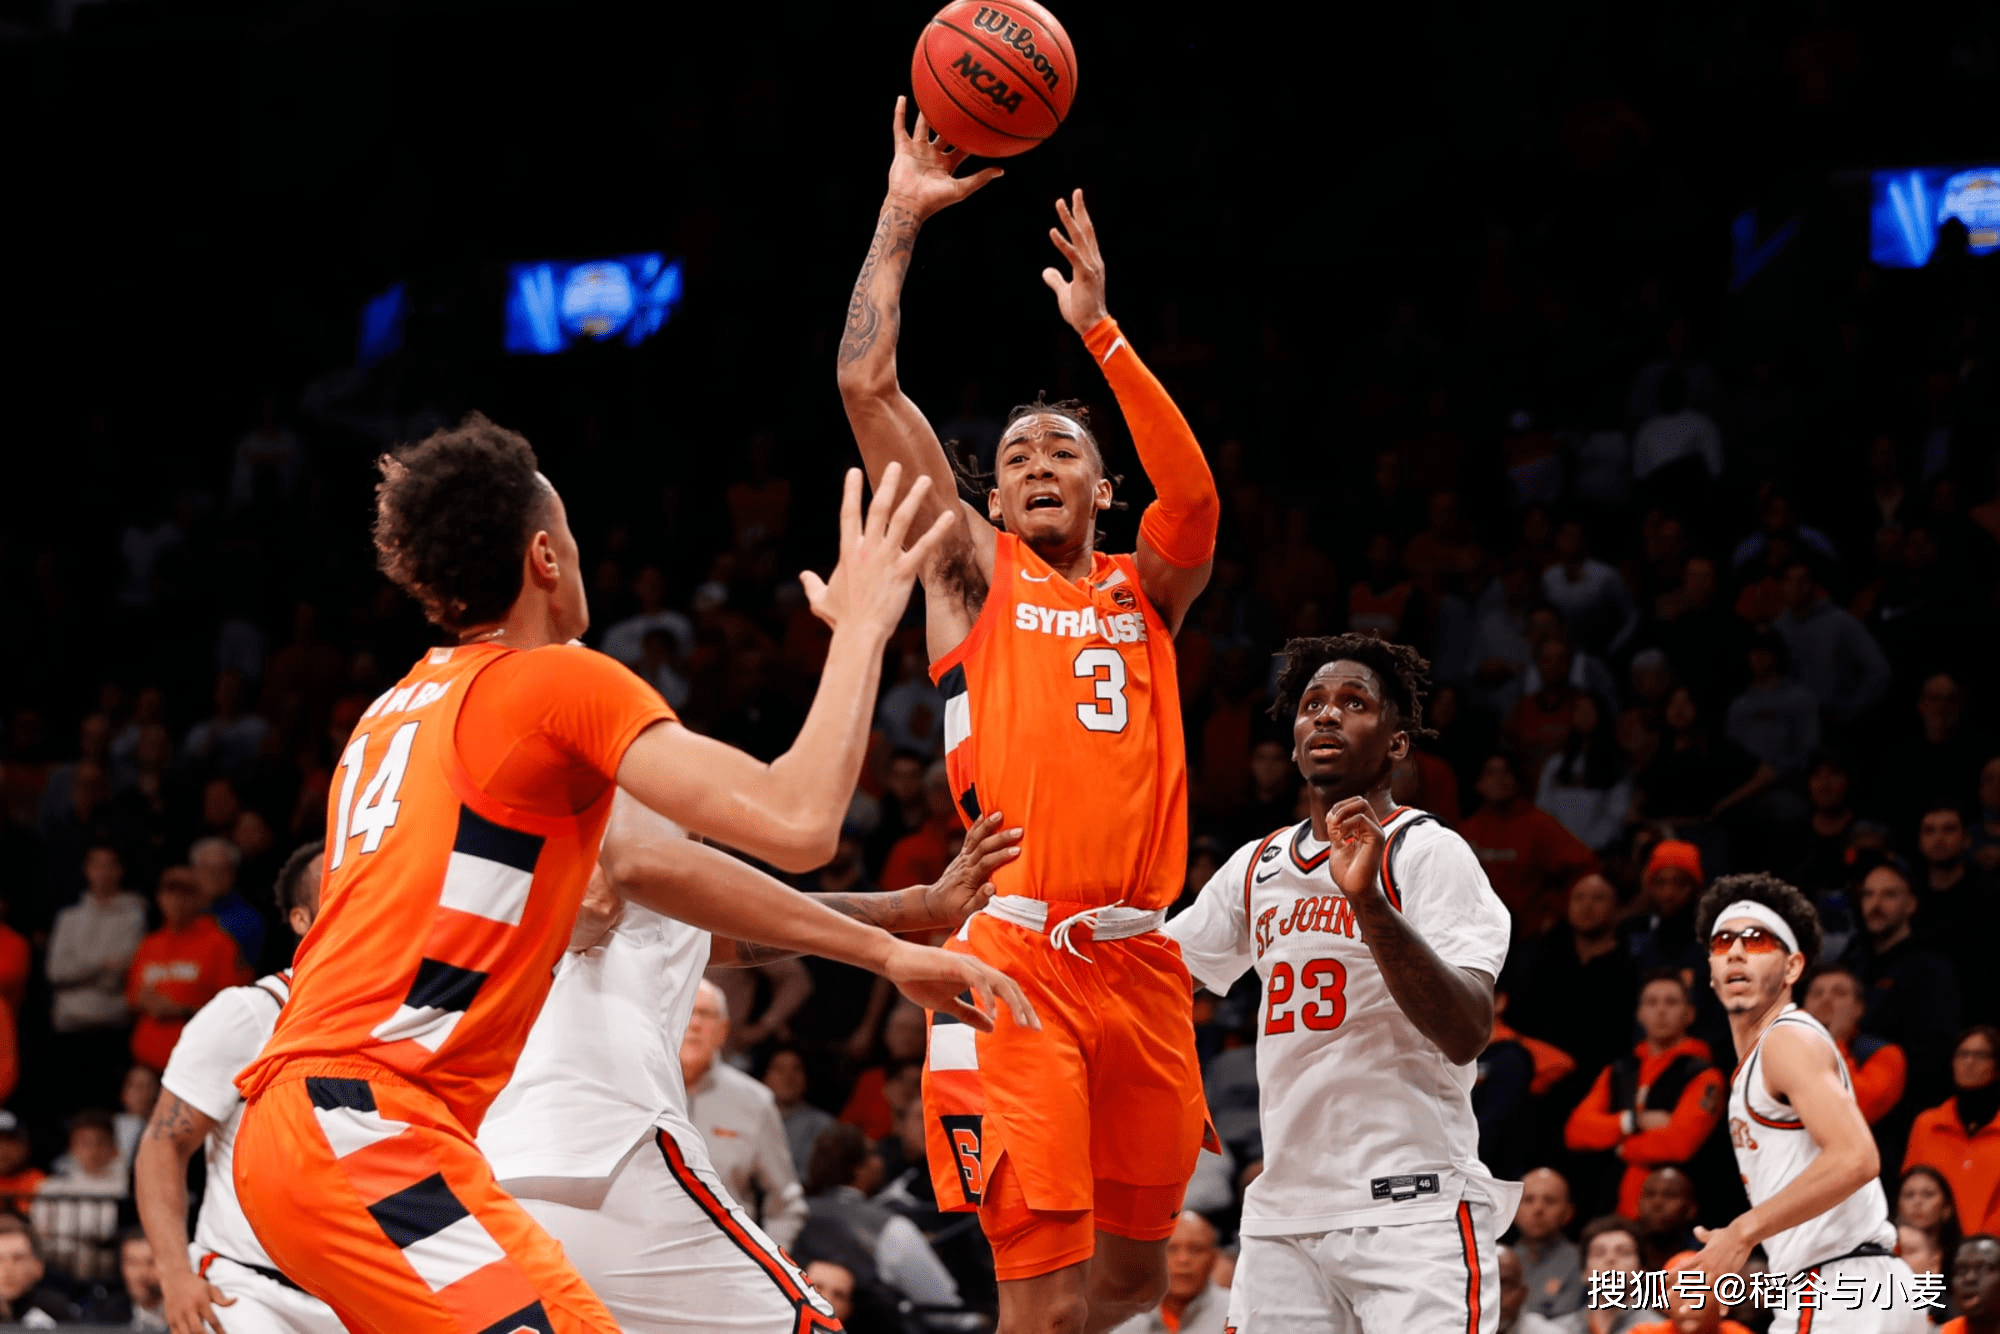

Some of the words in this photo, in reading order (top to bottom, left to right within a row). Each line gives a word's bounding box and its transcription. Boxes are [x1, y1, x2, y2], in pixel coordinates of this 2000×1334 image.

[952, 52, 1023, 115] NCAA
[973, 6, 1060, 90] Wilson
[1015, 602, 1148, 645] SYRAUSE
[1073, 647, 1128, 733] 3
[330, 719, 421, 872] 14
[1279, 895, 1367, 943] JOHN
[1264, 957, 1347, 1036] 23
